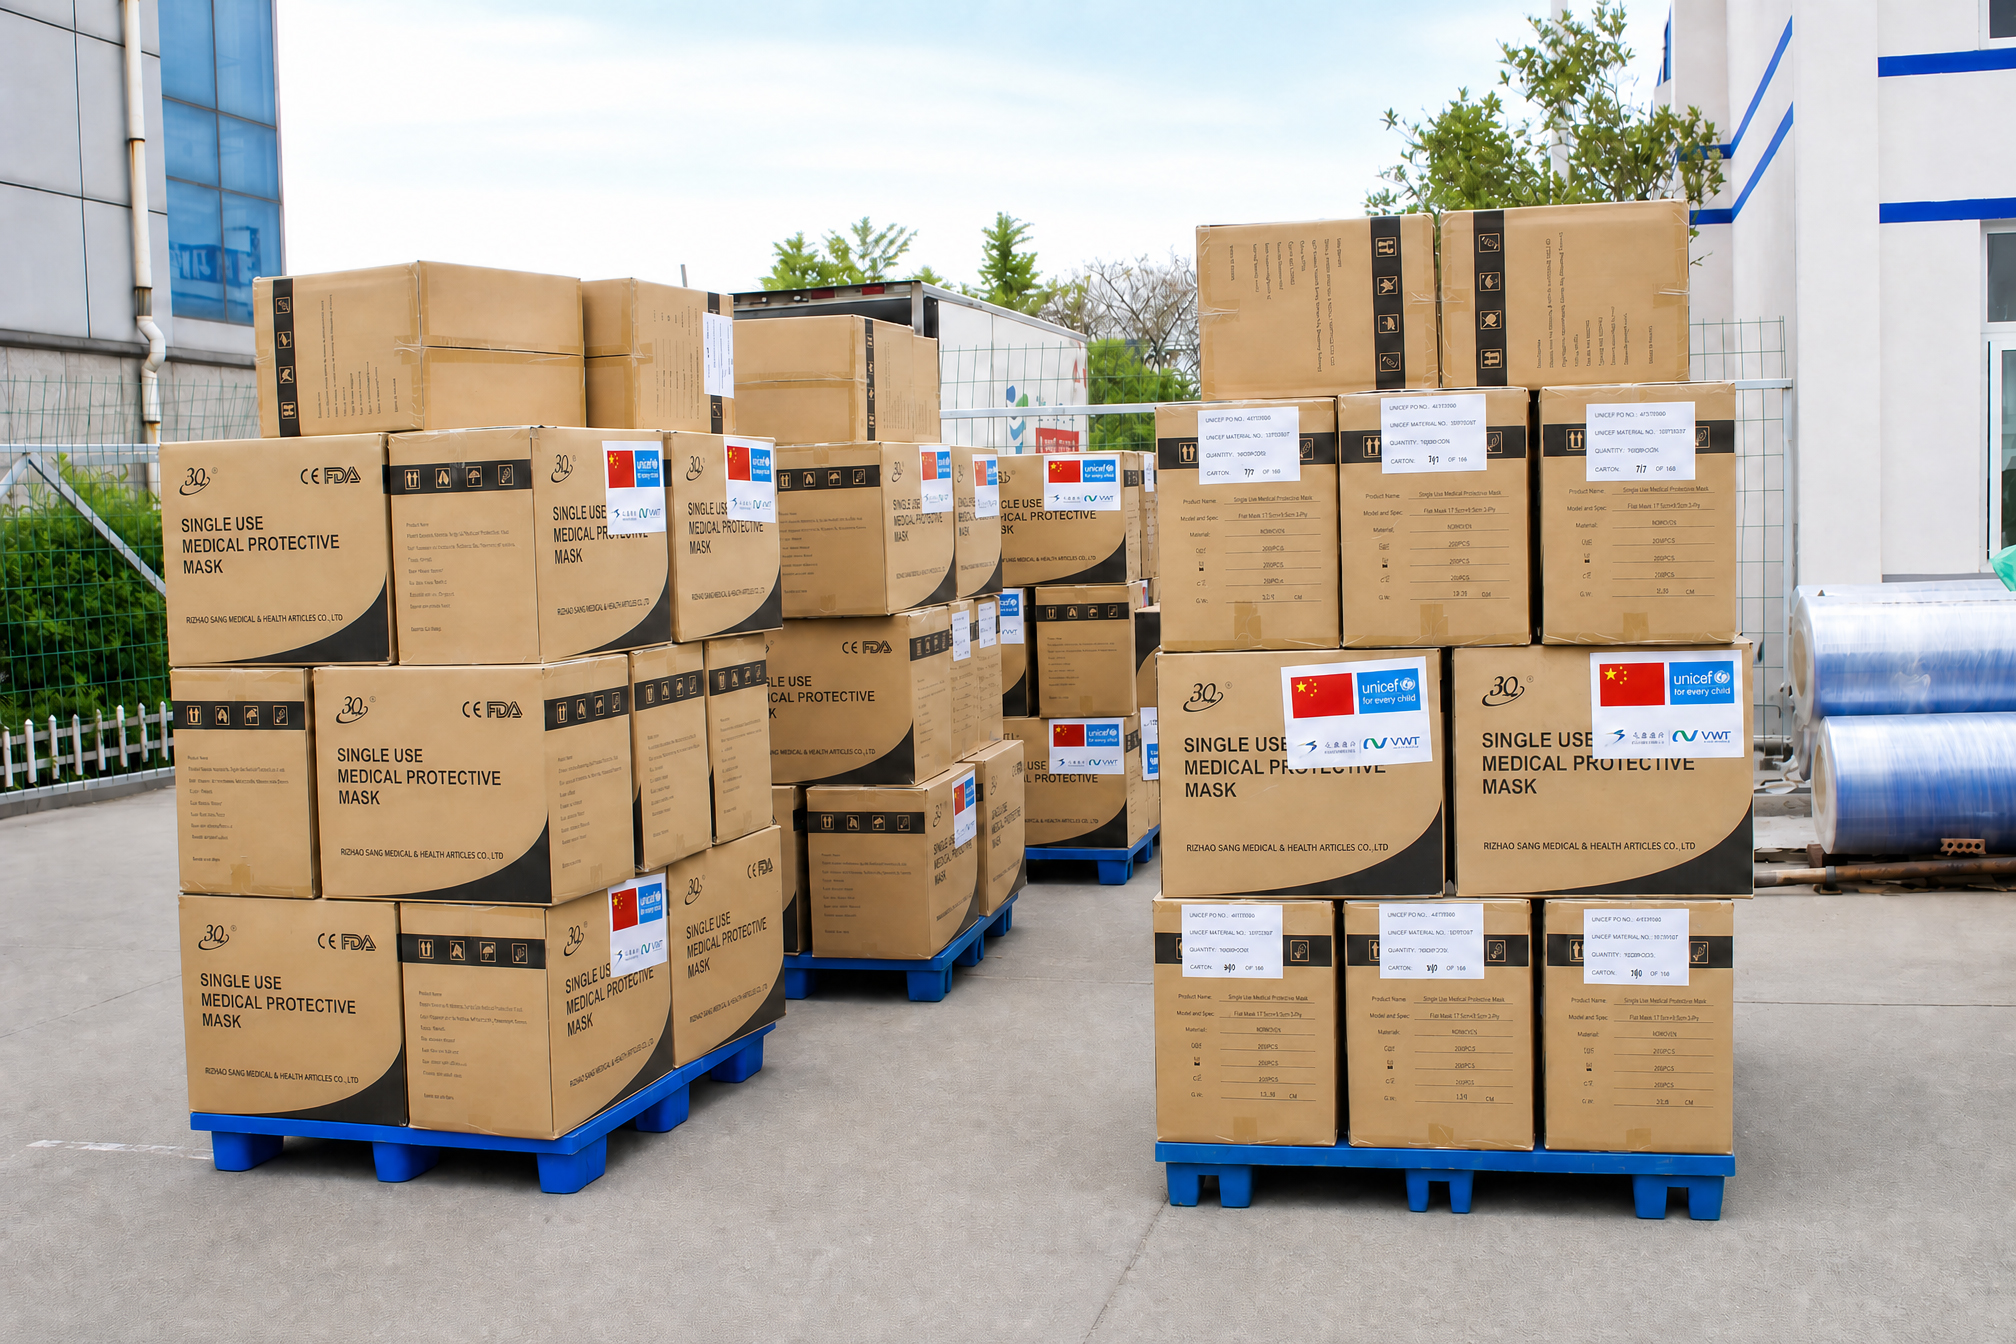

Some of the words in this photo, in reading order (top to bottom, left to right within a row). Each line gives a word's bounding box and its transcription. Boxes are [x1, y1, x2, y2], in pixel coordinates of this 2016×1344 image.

[300, 467, 320, 485] CE
[324, 466, 361, 484] FDA
[688, 502, 714, 516] SINGLE
[1022, 498, 1043, 508] USE
[553, 505, 587, 520] SINGLE
[1030, 510, 1097, 521] PROTECTIVE
[181, 517, 231, 532] SINGLE
[236, 516, 263, 531] USE
[689, 521, 721, 535] MEDICAL
[554, 526, 595, 542] MEDICAL
[182, 537, 244, 553] MEDICAL
[248, 534, 340, 552] PROTECTIVE
[690, 540, 711, 554] MASK
[555, 548, 583, 564] MASK
[183, 559, 223, 574] MASK
[210, 615, 228, 623] SANG
[229, 615, 255, 623] MEDICAL
[263, 614, 287, 623] HEALTH
[288, 614, 316, 622] ARTICLES
[842, 641, 858, 654] CE
[862, 641, 893, 654] FDA
[788, 676, 812, 687] USE
[1362, 678, 1399, 694] unicef
[1673, 671, 1713, 685] unicef
[798, 690, 876, 703] PROTECTIVE
[1374, 695, 1396, 706] every
[1397, 693, 1416, 703] child
[1686, 688, 1709, 697] every
[1711, 687, 1731, 695] child
[462, 700, 482, 718] CE
[486, 700, 523, 719] FDA
[1390, 736, 1420, 747] VWT
[1482, 732, 1551, 748] SINGLE
[1558, 732, 1593, 747] USE
[1701, 731, 1732, 741] VWT
[1184, 737, 1249, 753] SINGLE
[1255, 737, 1287, 752] USE
[337, 748, 390, 763] SINGLE
[394, 748, 423, 763] USE
[1482, 755, 1567, 772] MEDICAL
[1573, 755, 1695, 771] PROTECTIVE
[1027, 761, 1047, 771] USE
[1184, 759, 1264, 775] MEDICAL
[337, 768, 402, 785] MEDICAL
[406, 769, 502, 786] PROTECTIVE
[1034, 773, 1099, 783] PROTECTIVE
[1185, 782, 1237, 798] MASK
[1482, 778, 1537, 794] MASK
[338, 790, 381, 805] MASK
[340, 848, 364, 857] RIZHAO
[365, 848, 384, 857] SANG
[384, 849, 413, 858] MEDICAL
[420, 850, 445, 859] HEALTH
[446, 850, 476, 860] ARTICLES
[1186, 844, 1216, 852] RIZHAO
[1218, 844, 1240, 852] SANG
[1242, 844, 1278, 852] MEDICAL
[1287, 843, 1318, 852] HEALTH
[1319, 843, 1356, 852] ARTICLES
[1484, 842, 1515, 850] RIZHAO
[1517, 842, 1540, 850] SANG
[1542, 842, 1580, 850] MEDICAL
[1590, 842, 1622, 850] HEALTH
[1624, 842, 1662, 850] ARTICLES
[758, 858, 773, 876] FDA
[686, 917, 714, 939] SINGLE
[716, 911, 731, 928] USE
[317, 932, 337, 950] CE
[341, 933, 377, 952] FDA
[687, 934, 721, 960] MEDICAL
[722, 916, 767, 945] PROTECTIVE
[687, 957, 711, 979] MASK
[200, 973, 250, 989] SINGLE
[254, 975, 282, 990] USE
[565, 967, 598, 994] SINGLE
[600, 963, 611, 979] US
[567, 988, 606, 1015] MEDICAL
[607, 967, 654, 999] PROTECTIVE
[201, 992, 262, 1010] MEDICAL
[266, 996, 357, 1015] PROTECTIVE
[202, 1012, 242, 1029] MASK
[567, 1012, 594, 1037] MASK
[228, 1068, 246, 1077] SANG
[246, 1069, 273, 1079] MEDICAL
[279, 1072, 304, 1081] HEALTH
[304, 1073, 333, 1083] ARTICLES
